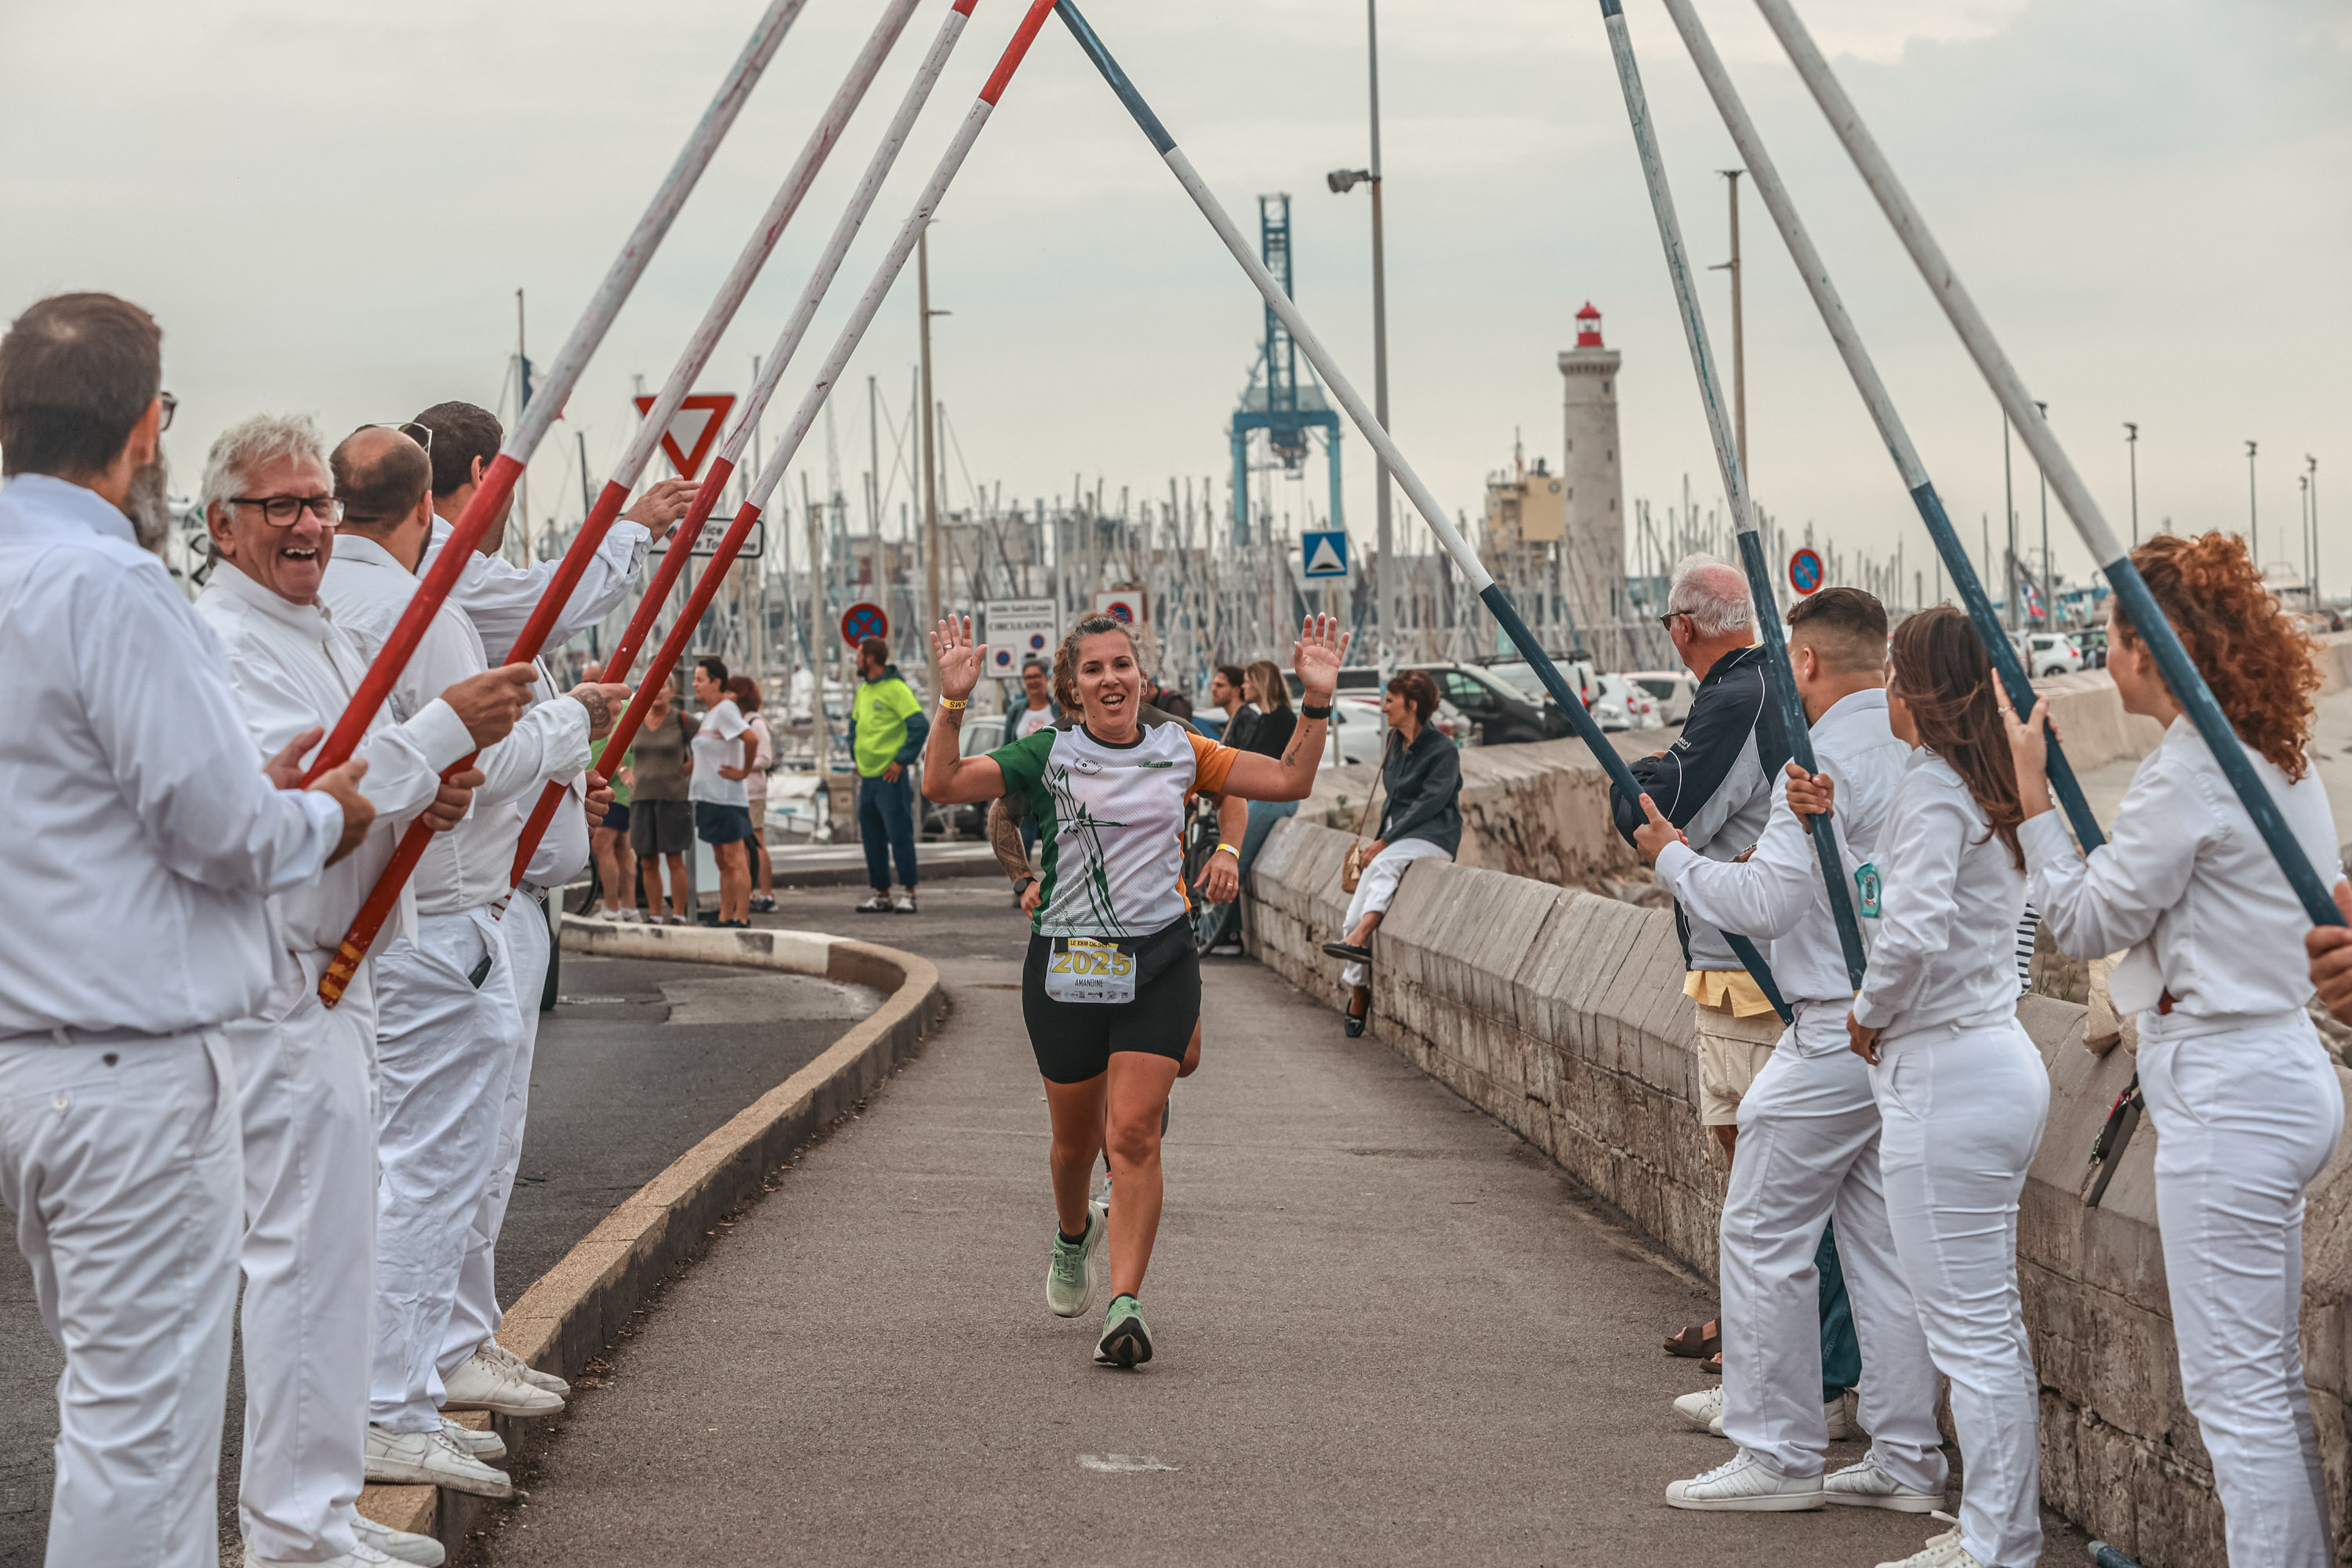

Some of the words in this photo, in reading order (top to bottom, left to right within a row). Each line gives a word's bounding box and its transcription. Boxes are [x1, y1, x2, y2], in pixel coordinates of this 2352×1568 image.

[706, 538, 757, 550] Tome
[1052, 951, 1131, 976] 2025
[1075, 978, 1104, 988] AMANDINE
